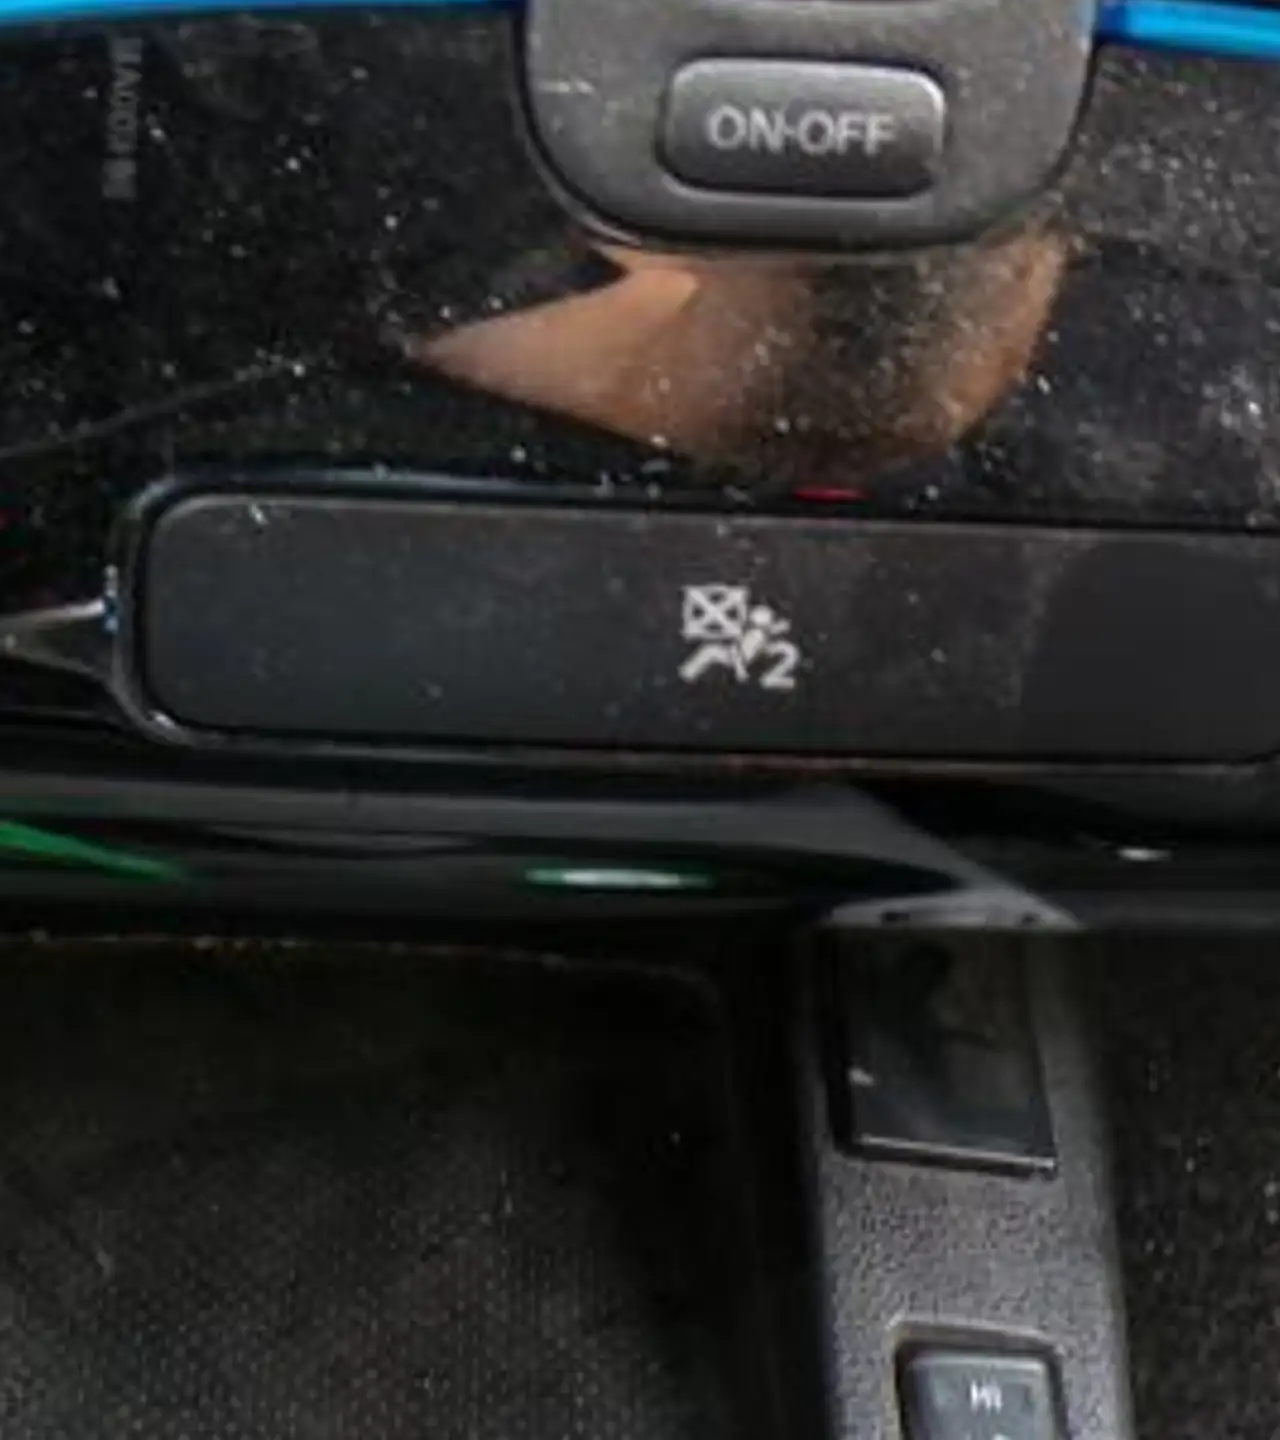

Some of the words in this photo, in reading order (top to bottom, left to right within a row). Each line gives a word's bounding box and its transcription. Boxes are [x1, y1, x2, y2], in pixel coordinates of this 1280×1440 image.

[708, 105, 896, 156] ON-OFF
[760, 639, 800, 689] 2
[969, 1380, 1003, 1410] HI
